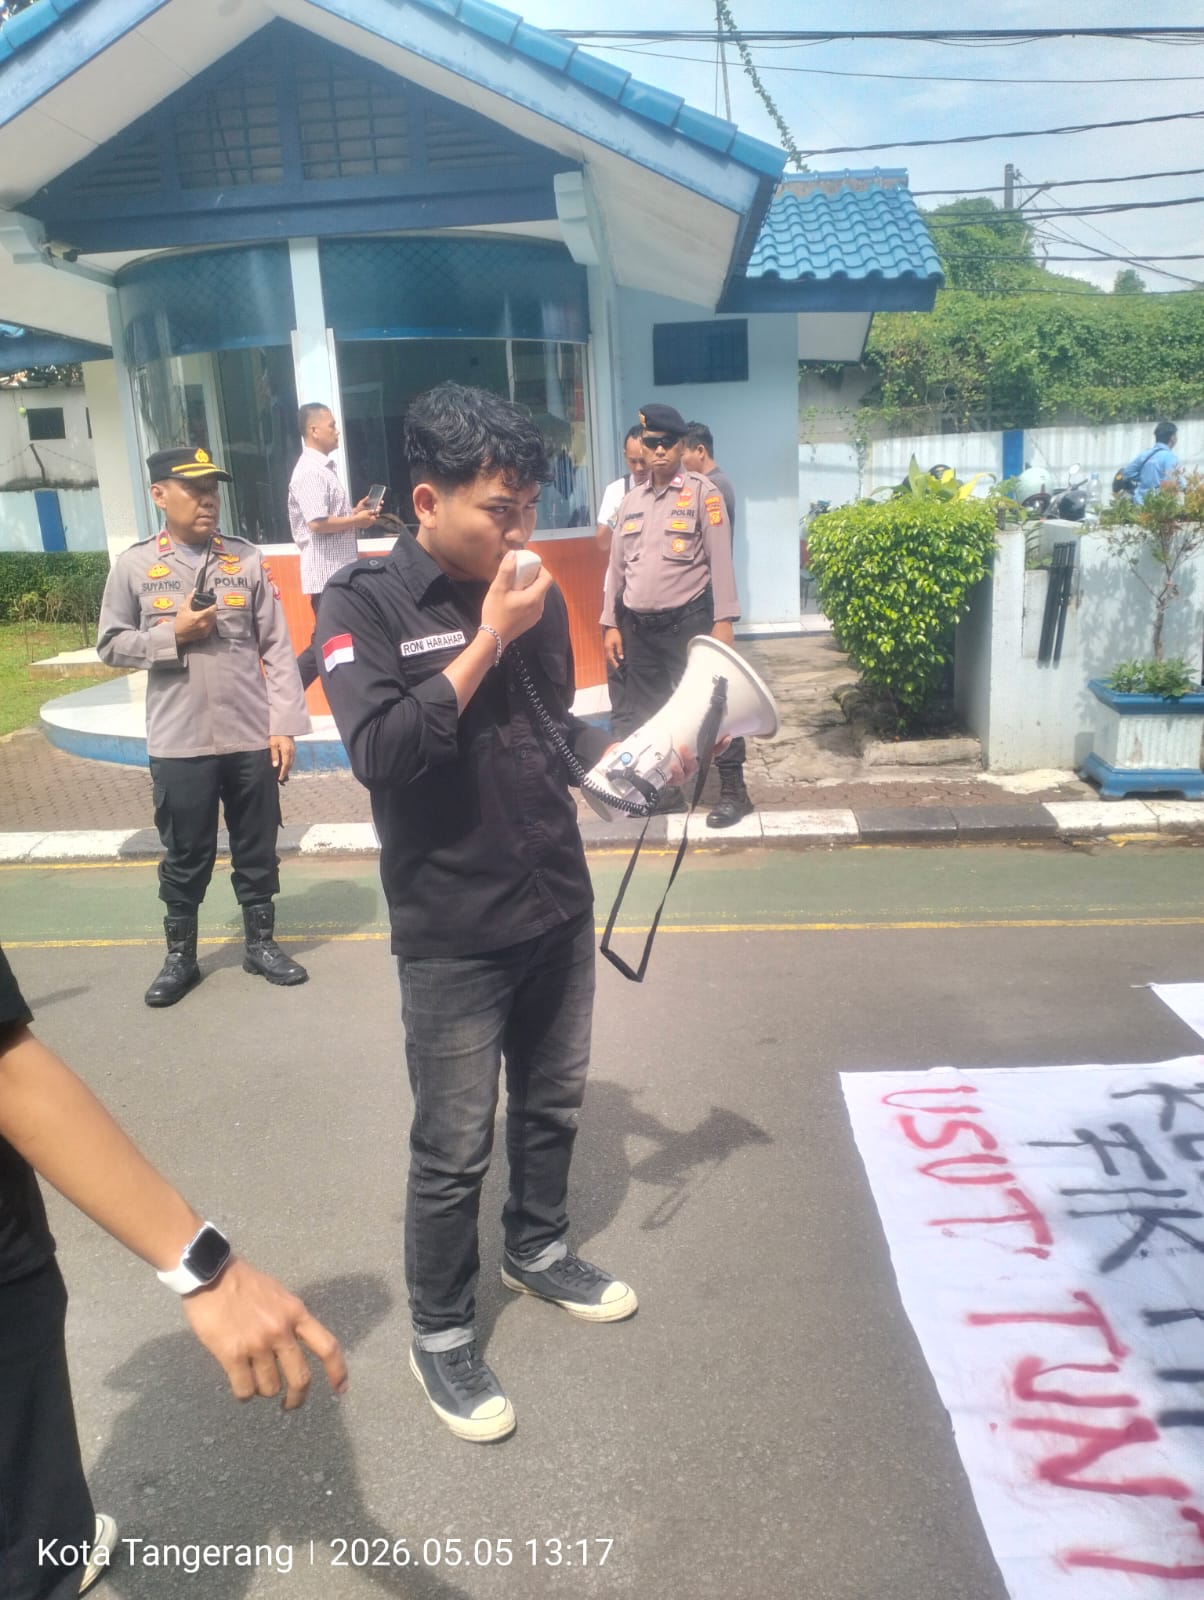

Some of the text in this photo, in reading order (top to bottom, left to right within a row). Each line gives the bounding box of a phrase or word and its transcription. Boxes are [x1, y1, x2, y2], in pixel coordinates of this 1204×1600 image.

[671, 509, 695, 517] POLRI
[214, 576, 248, 587] POLRI
[403, 633, 463, 655] RONI HARAHAP
